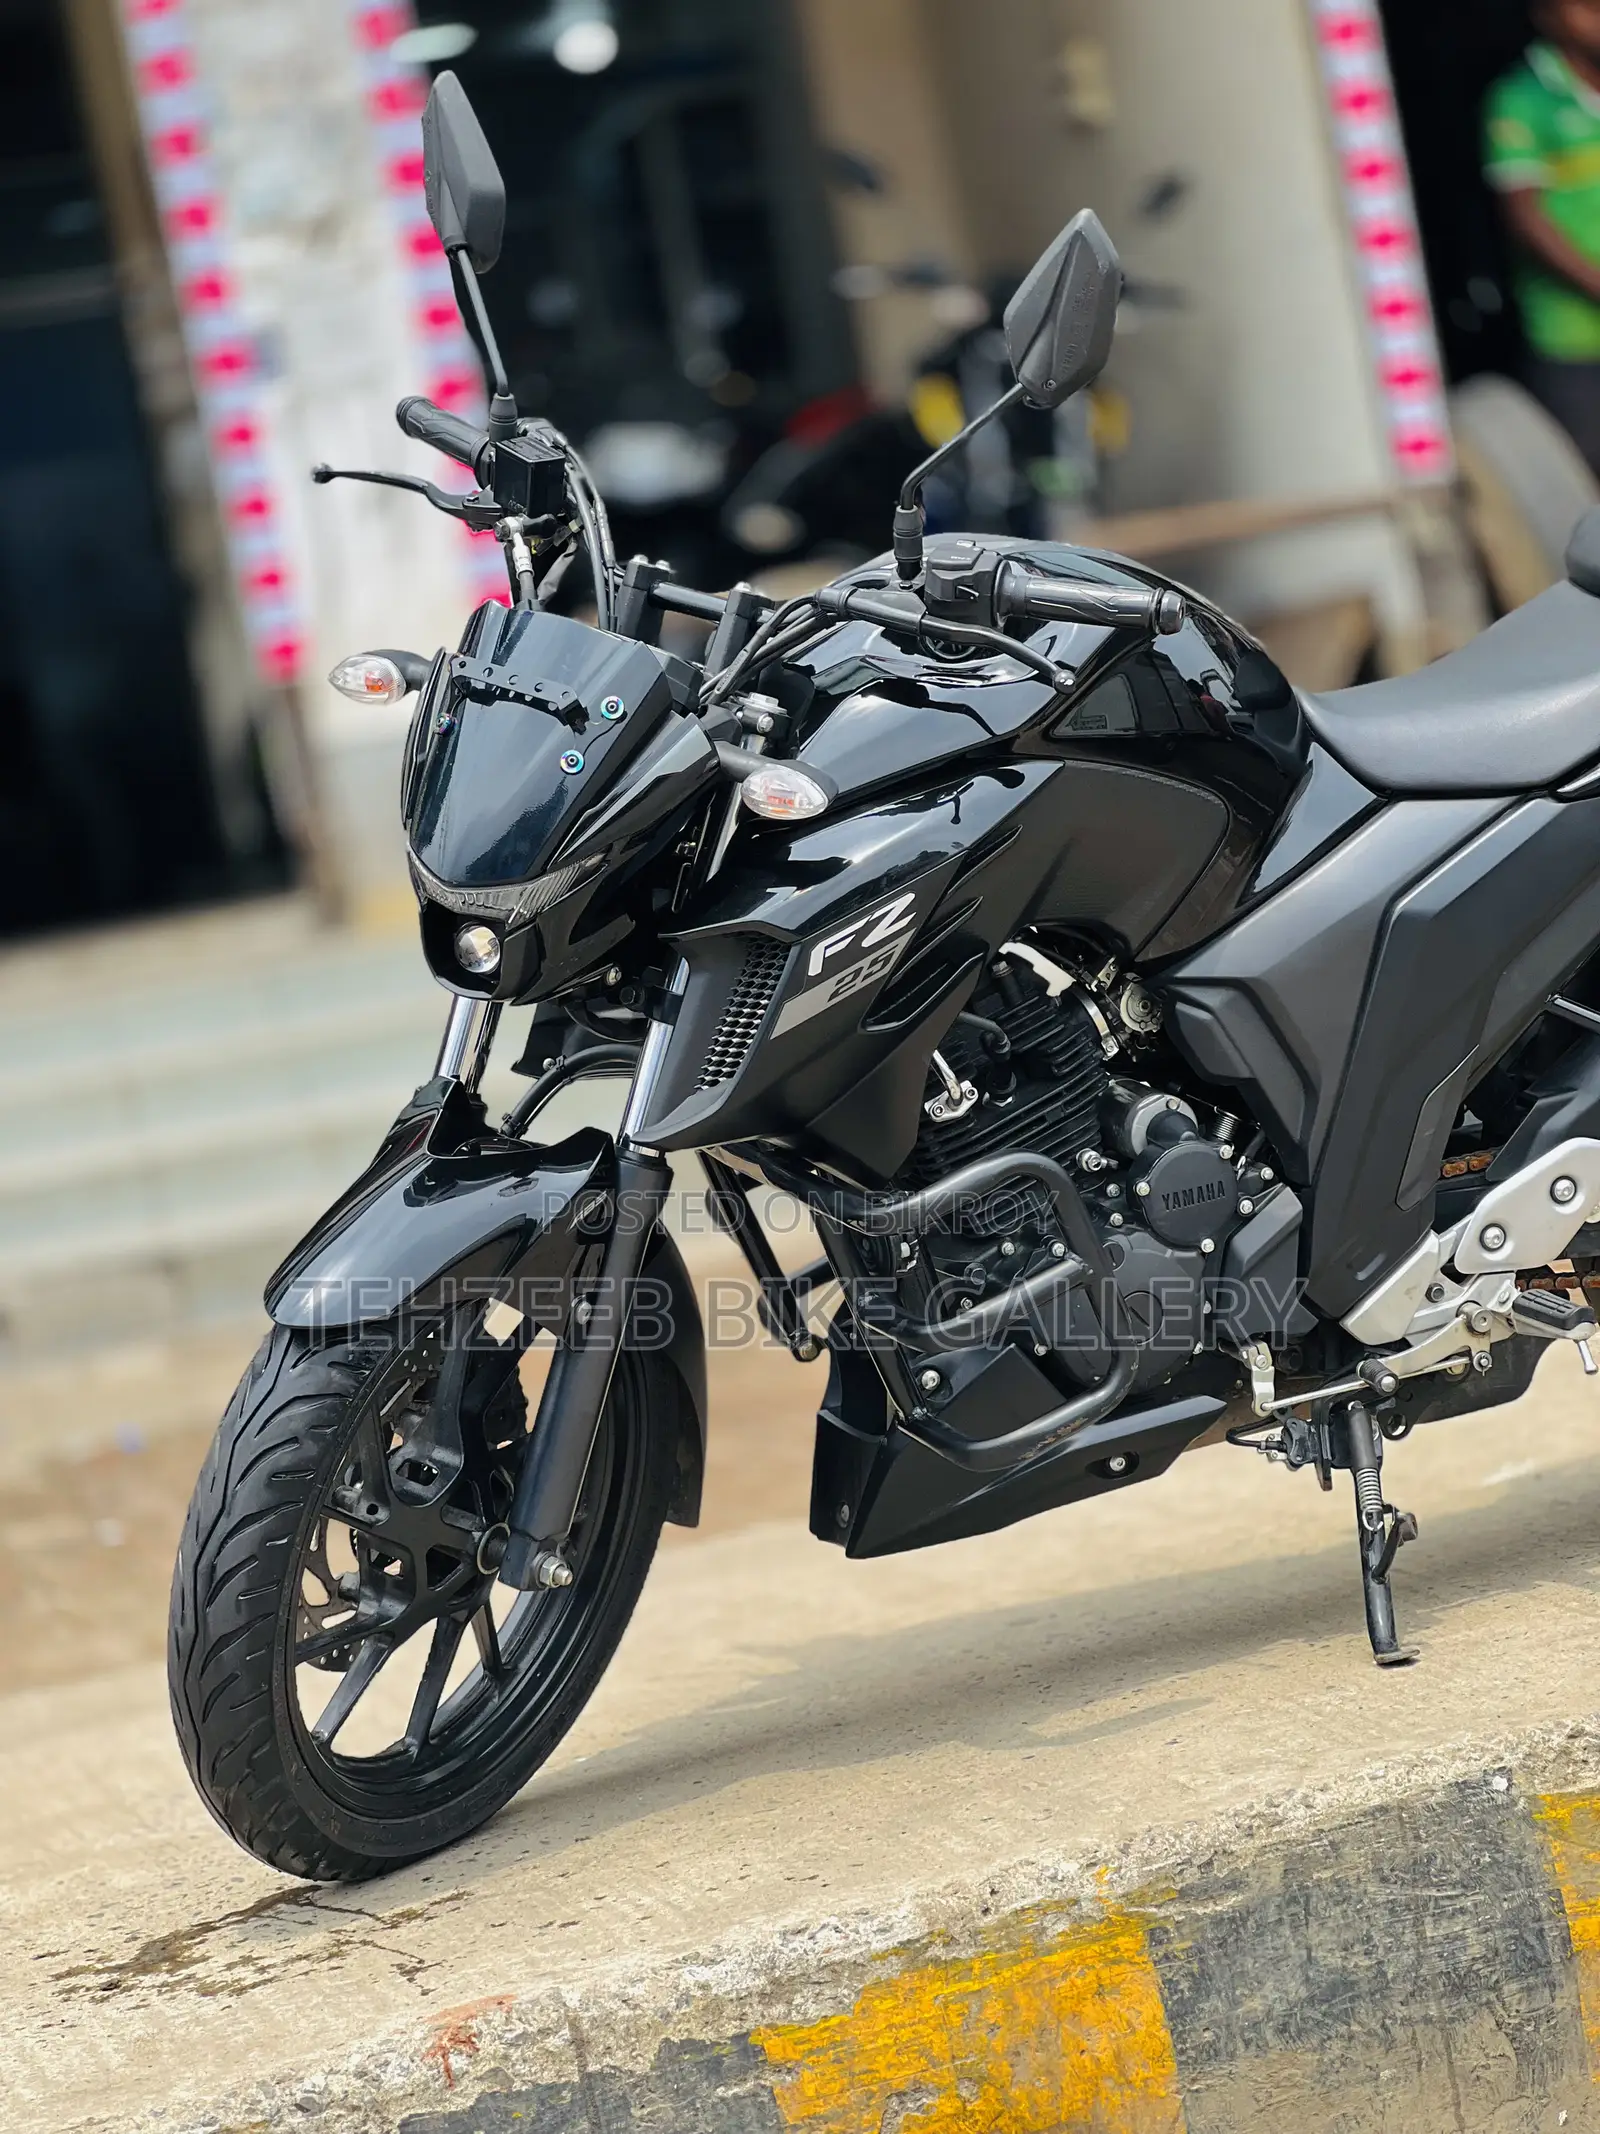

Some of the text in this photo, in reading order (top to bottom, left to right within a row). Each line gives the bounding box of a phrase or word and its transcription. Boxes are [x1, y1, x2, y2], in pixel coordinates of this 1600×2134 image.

[807, 891, 917, 977] FZ
[827, 946, 897, 1002] 25
[1161, 1179, 1226, 1212] YAMAHA
